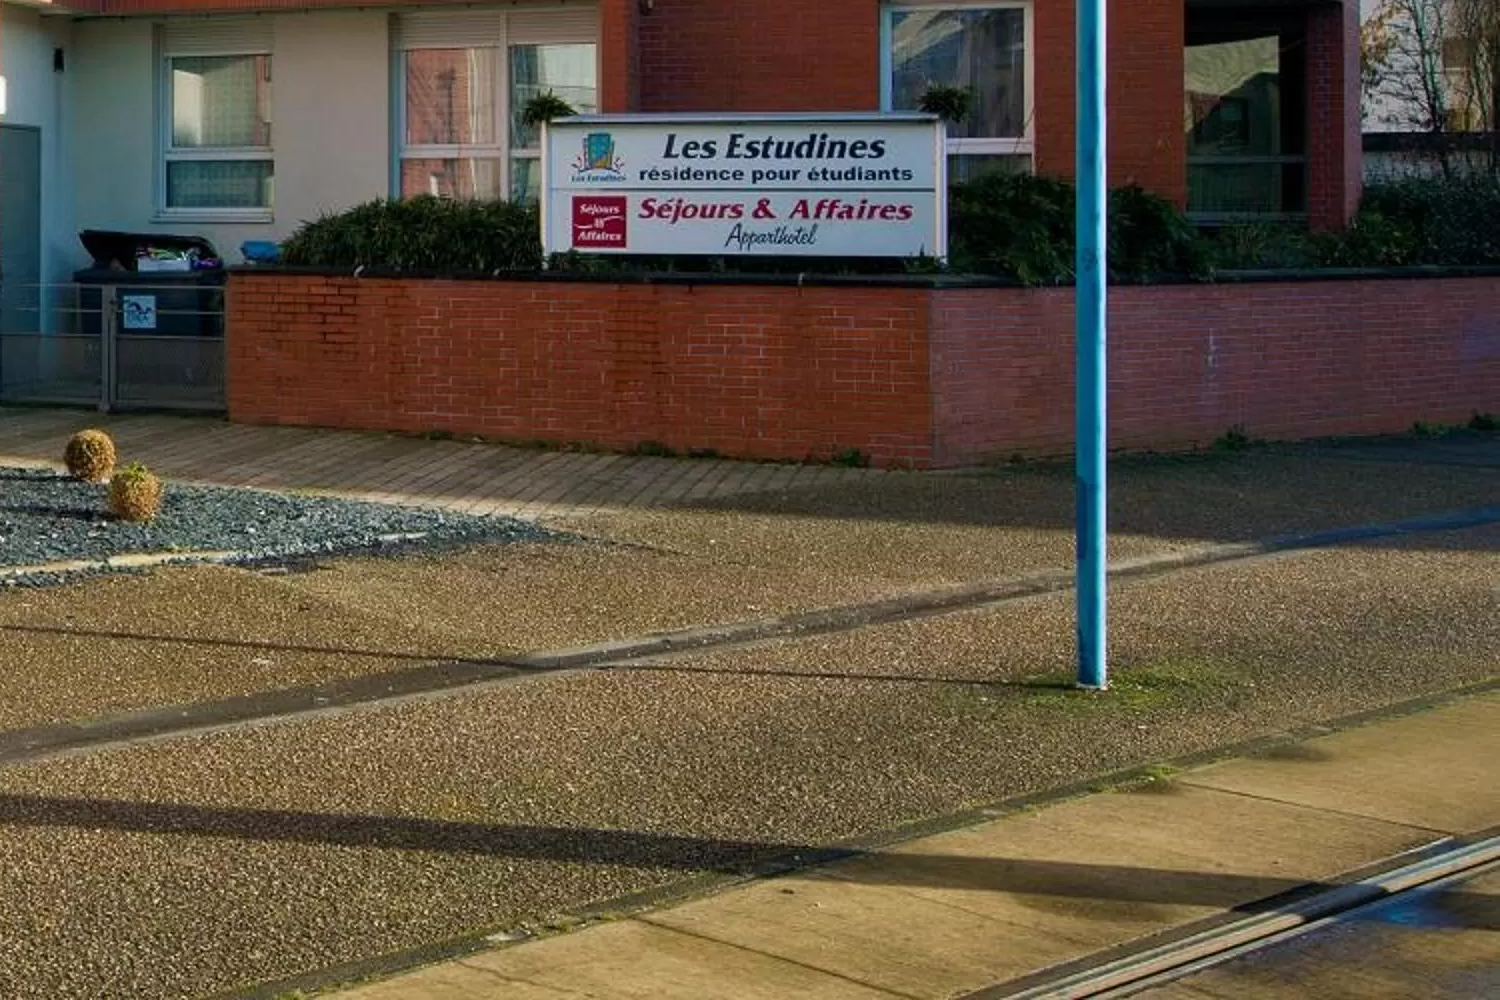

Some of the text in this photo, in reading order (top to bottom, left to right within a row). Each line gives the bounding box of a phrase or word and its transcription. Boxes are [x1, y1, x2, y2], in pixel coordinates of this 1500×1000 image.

[663, 133, 885, 159] Les Estudines
[639, 166, 913, 184] résidence pour étudiants
[638, 198, 913, 224] Séjours & Affaires
[724, 222, 819, 251] Apparthotel
